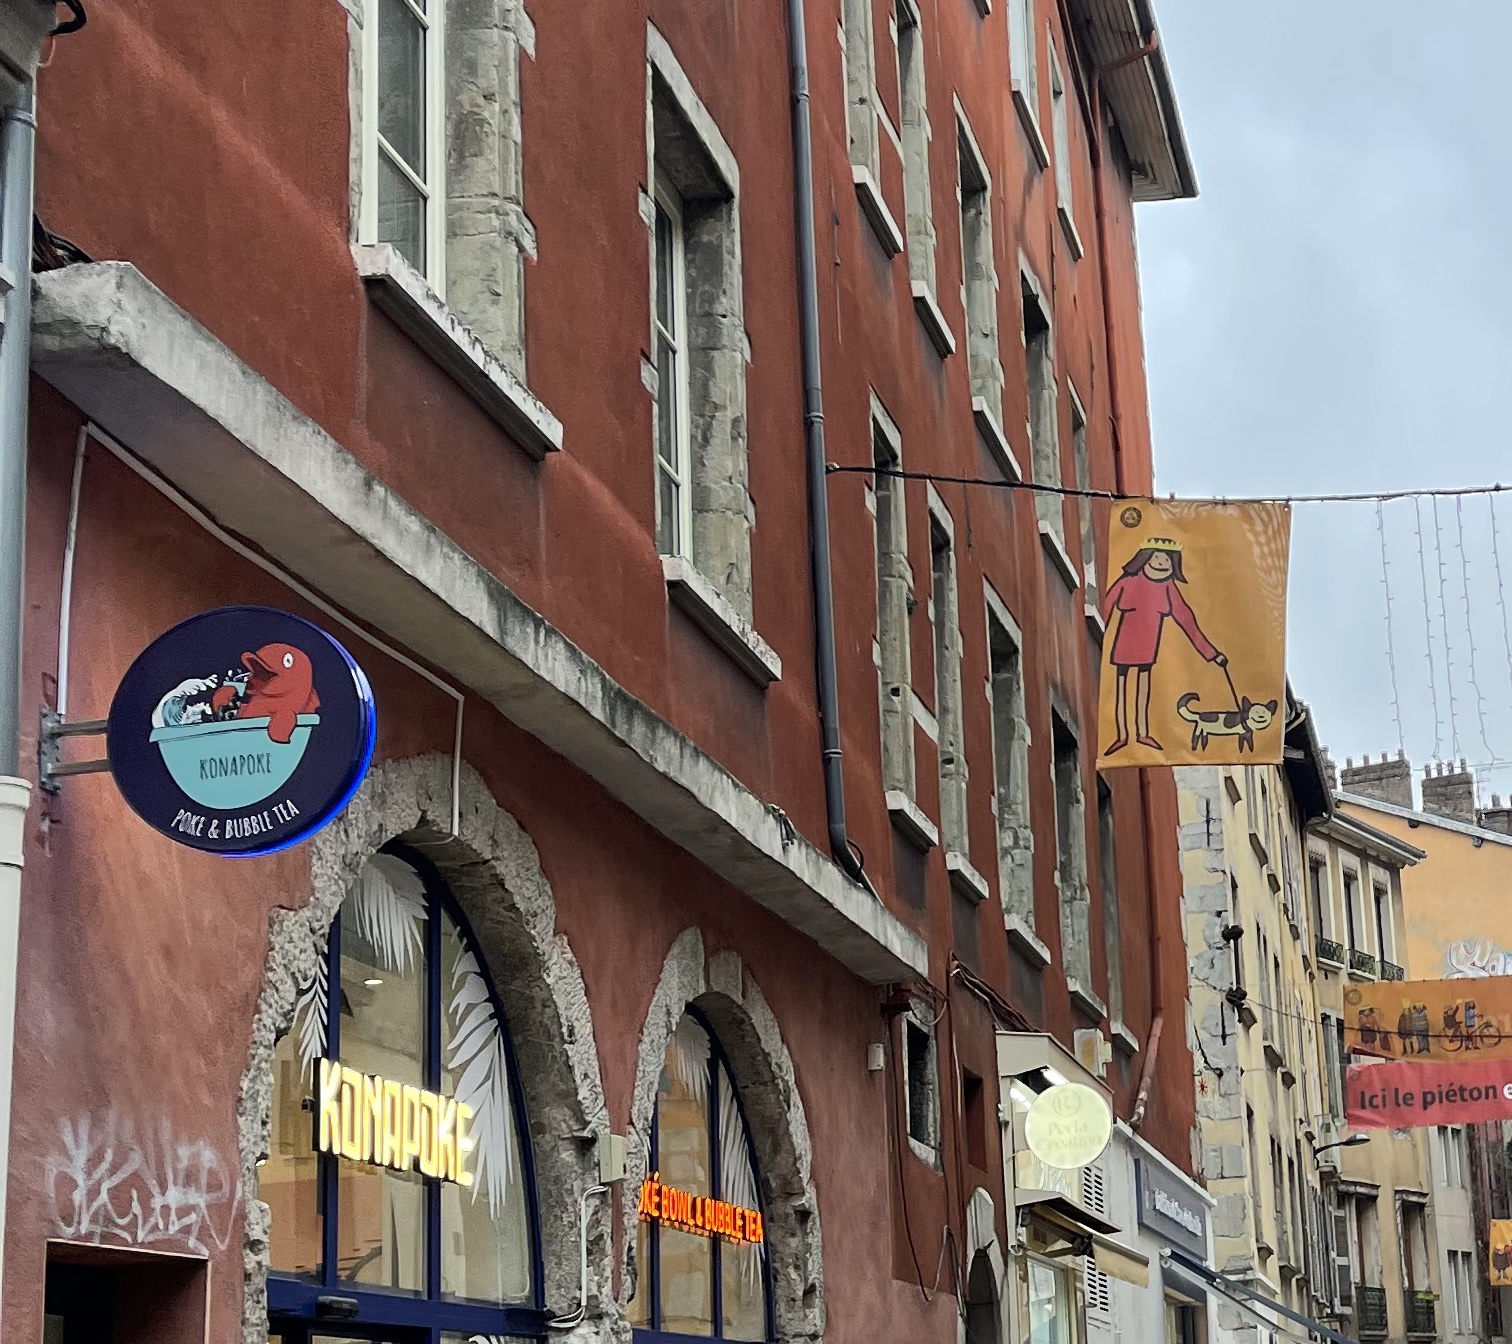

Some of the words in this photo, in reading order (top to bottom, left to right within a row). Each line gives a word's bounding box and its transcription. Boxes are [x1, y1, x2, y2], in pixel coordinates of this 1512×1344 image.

[199, 753, 273, 781] KONAPOKE
[171, 808, 205, 838] POKE
[207, 819, 220, 839] &
[224, 810, 275, 839] BUBBLE
[271, 799, 300, 825] TEA
[1360, 1087, 1387, 1110] Ici
[1394, 1087, 1415, 1108] le
[1422, 1082, 1498, 1112] piéton
[319, 1057, 475, 1188] KONAPOKE
[1048, 1119, 1088, 1136] Perla
[661, 1184, 695, 1226] BOWL
[705, 1196, 743, 1240] BUBBLE
[743, 1208, 764, 1244] TEA
